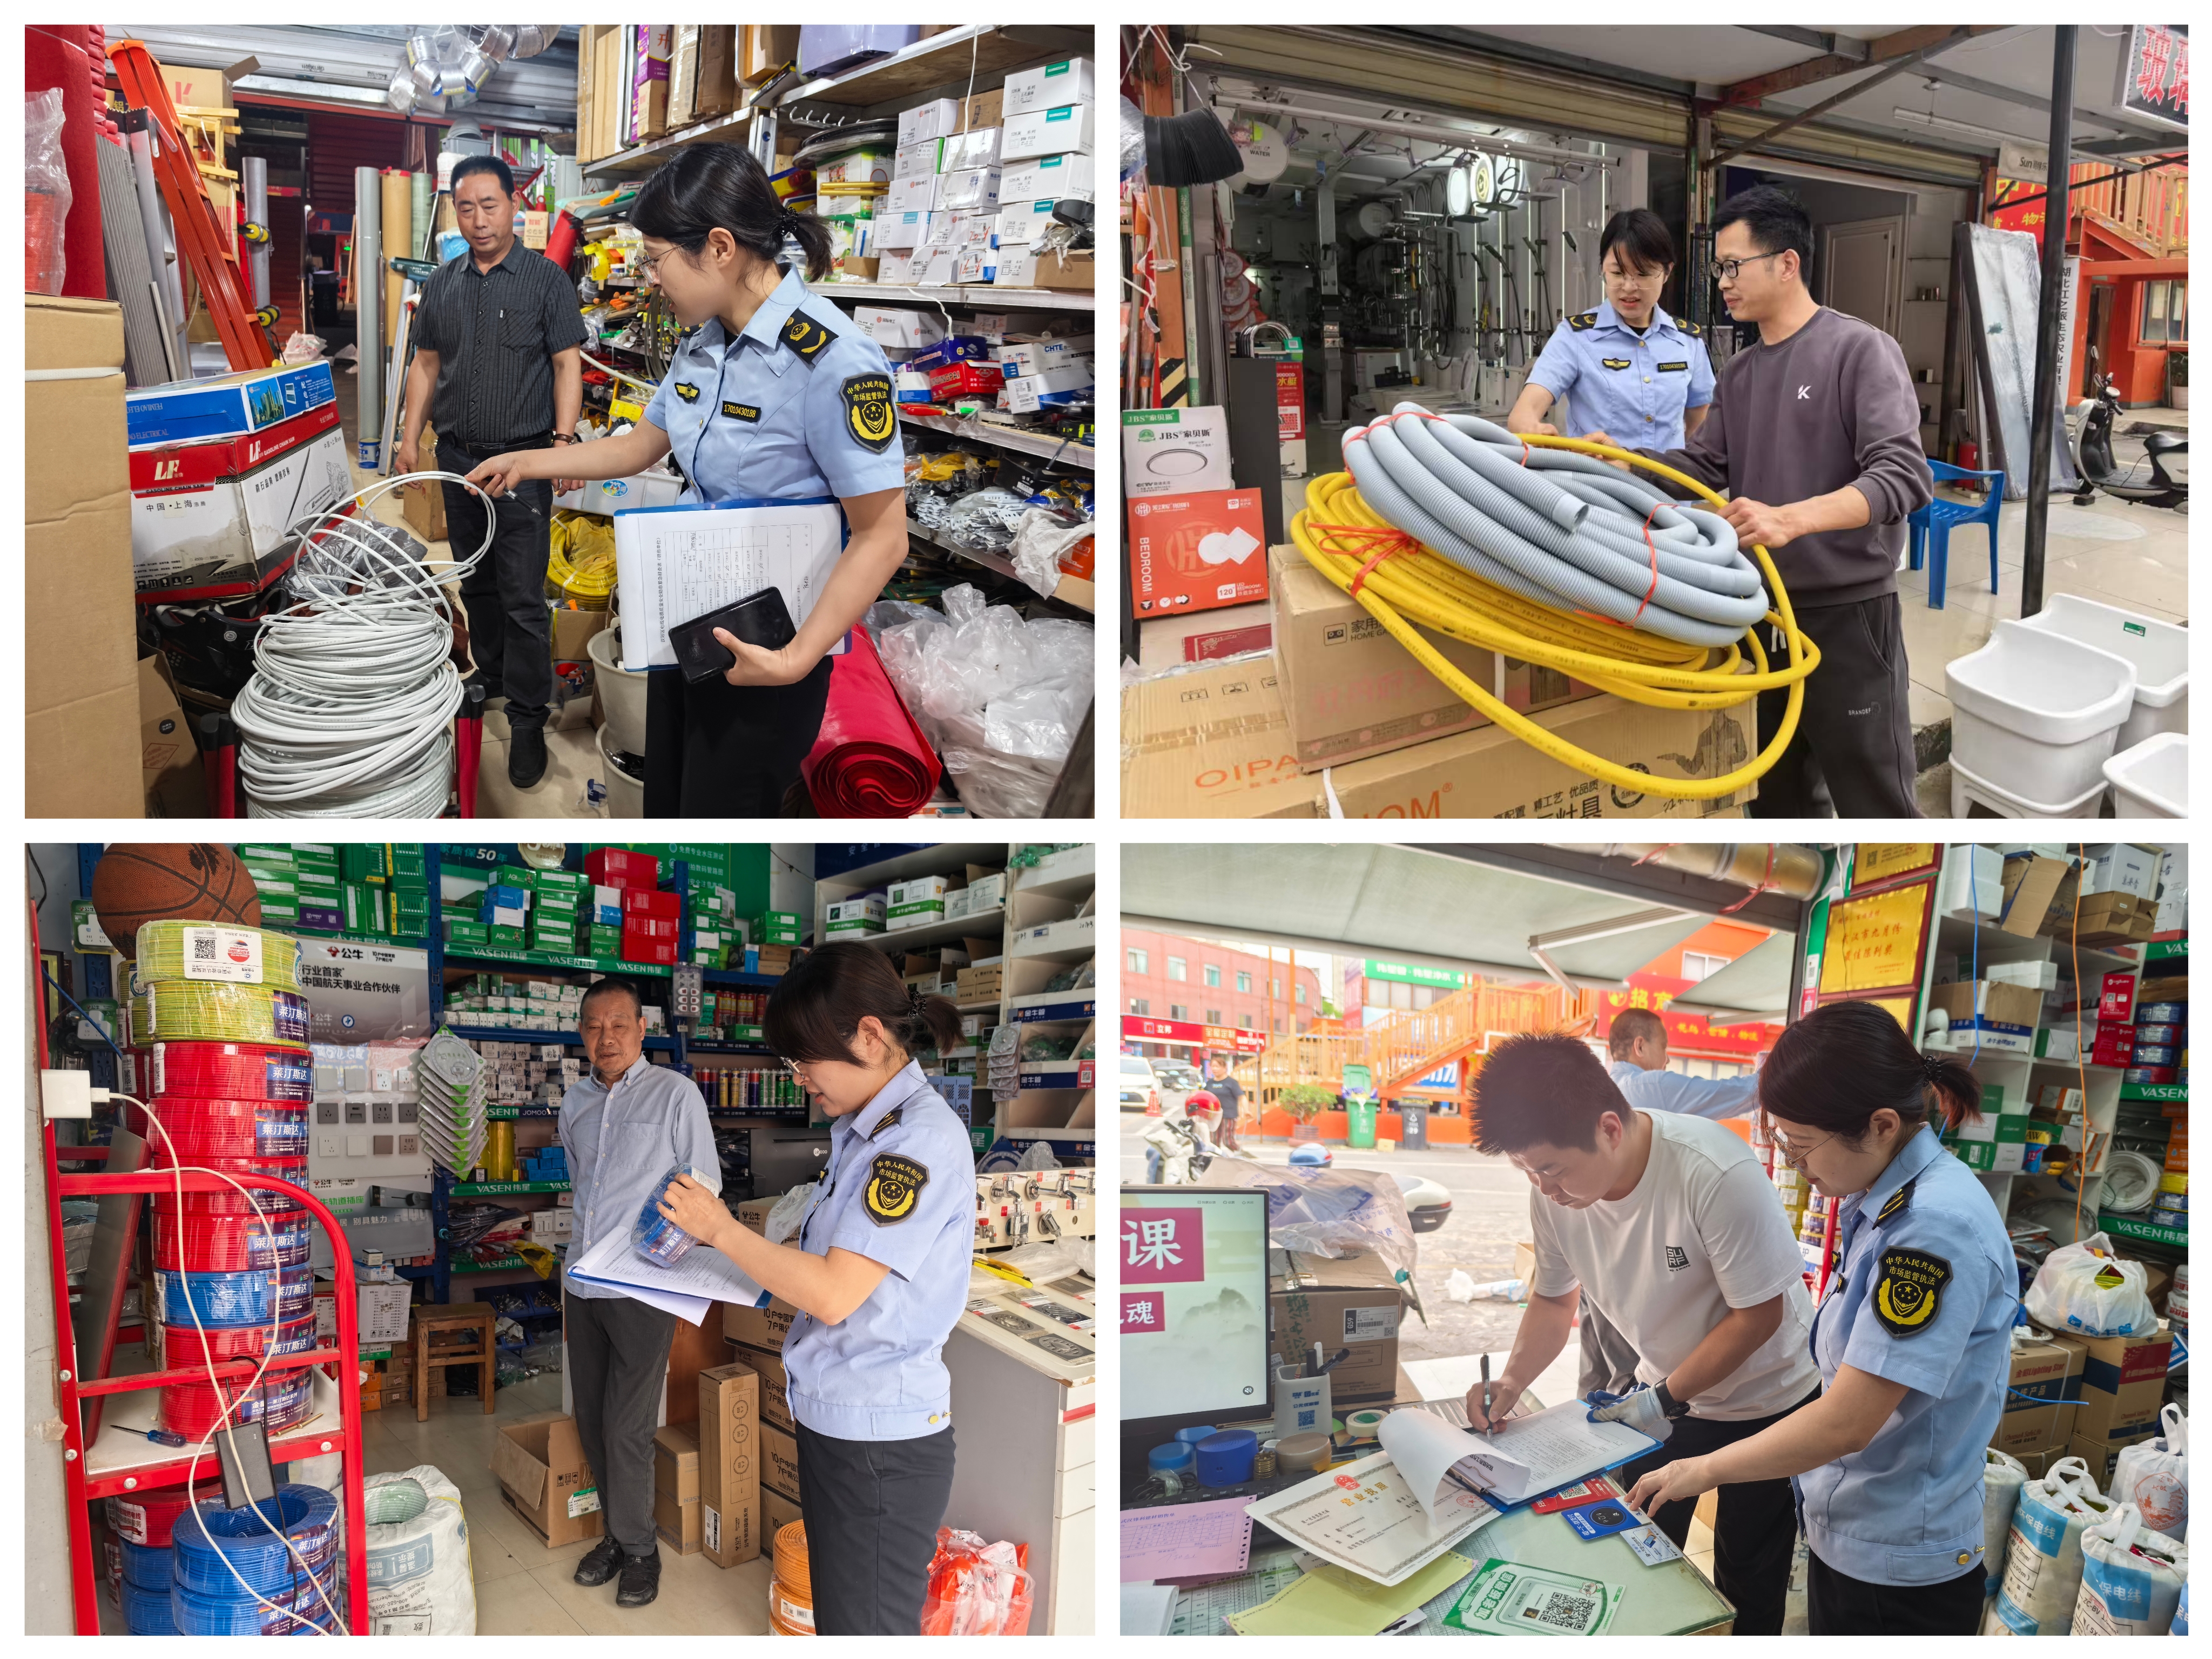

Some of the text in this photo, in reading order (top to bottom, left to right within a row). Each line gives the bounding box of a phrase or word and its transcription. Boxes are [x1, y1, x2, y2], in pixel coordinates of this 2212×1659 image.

[847, 380, 889, 395] 中华人民共和国
[853, 390, 887, 402] 市场监管执法
[724, 403, 756, 418] 17010430188
[1219, 588, 1233, 596] 120
[341, 948, 363, 960] 公牛
[278, 1006, 307, 1022] 莱汀斯达
[1024, 1008, 1046, 1017] 金牛管
[273, 1067, 307, 1081] 莱汀斯达
[262, 1124, 299, 1136] 莱汀斯达
[876, 1159, 924, 1182] 中华人民共和国
[879, 1168, 917, 1186] 市场监管执法
[1121, 1218, 1183, 1270] 课
[1885, 1256, 1945, 1280] 中华人民共和国
[1889, 1266, 1937, 1286] 市场监管执法
[272, 1338, 307, 1355] 莱汀斯达
